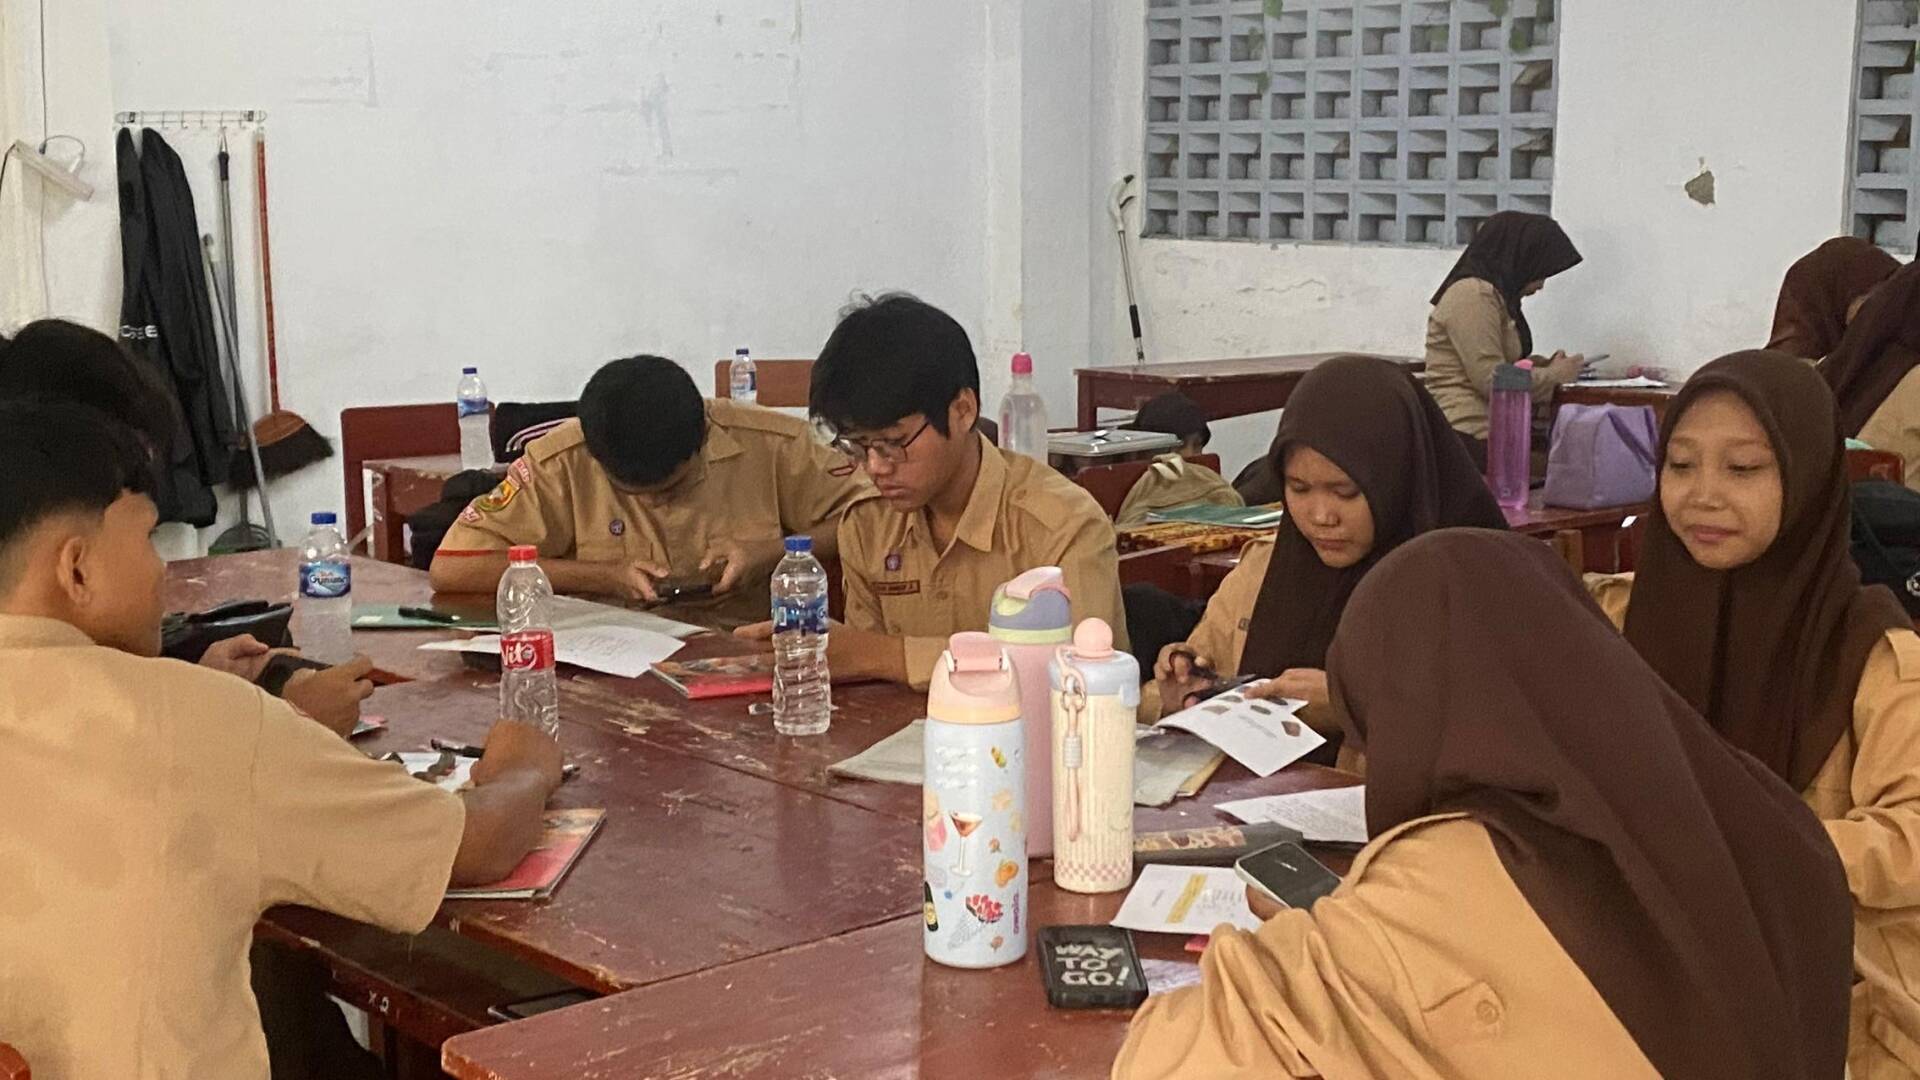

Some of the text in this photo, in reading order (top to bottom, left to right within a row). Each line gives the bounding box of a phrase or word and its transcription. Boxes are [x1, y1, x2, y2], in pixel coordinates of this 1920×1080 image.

[1055, 944, 1124, 960] WAY
[1055, 957, 1109, 971] TO
[1061, 966, 1130, 987] GO!
